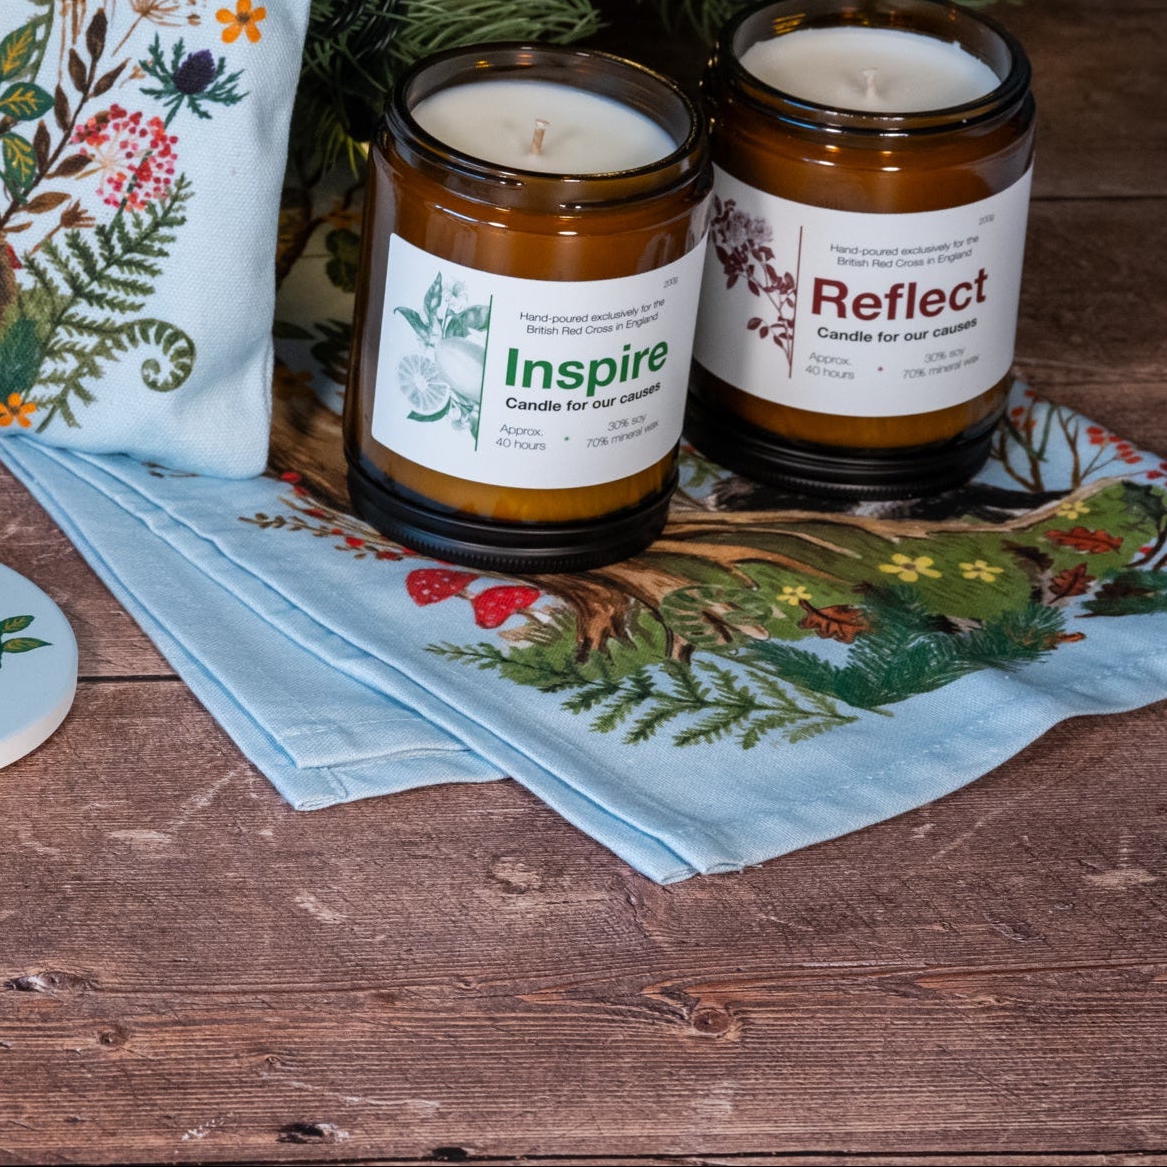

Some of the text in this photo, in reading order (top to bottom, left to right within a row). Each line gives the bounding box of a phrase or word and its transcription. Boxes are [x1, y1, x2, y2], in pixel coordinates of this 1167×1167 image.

[830, 235, 979, 257] Hand-poured exclusively for the
[837, 249, 973, 268] British Red Cross in England
[811, 267, 989, 321] Reflect
[520, 298, 665, 325] Hand-poured exclusively for the
[526, 312, 659, 335] British Red Cross in England
[817, 318, 978, 343] Candle for our causes
[809, 352, 852, 366] Approx.
[924, 347, 966, 363] 30% soy
[505, 341, 668, 397] Inspire
[805, 365, 855, 380] 40 hours
[903, 354, 980, 379] 70% mineral wax
[505, 381, 661, 412] Candle for our causes
[499, 424, 544, 437] Approx.
[607, 413, 647, 432] 30% soy
[495, 437, 546, 451] 40 hours
[586, 420, 660, 449] 70% mineral wax
